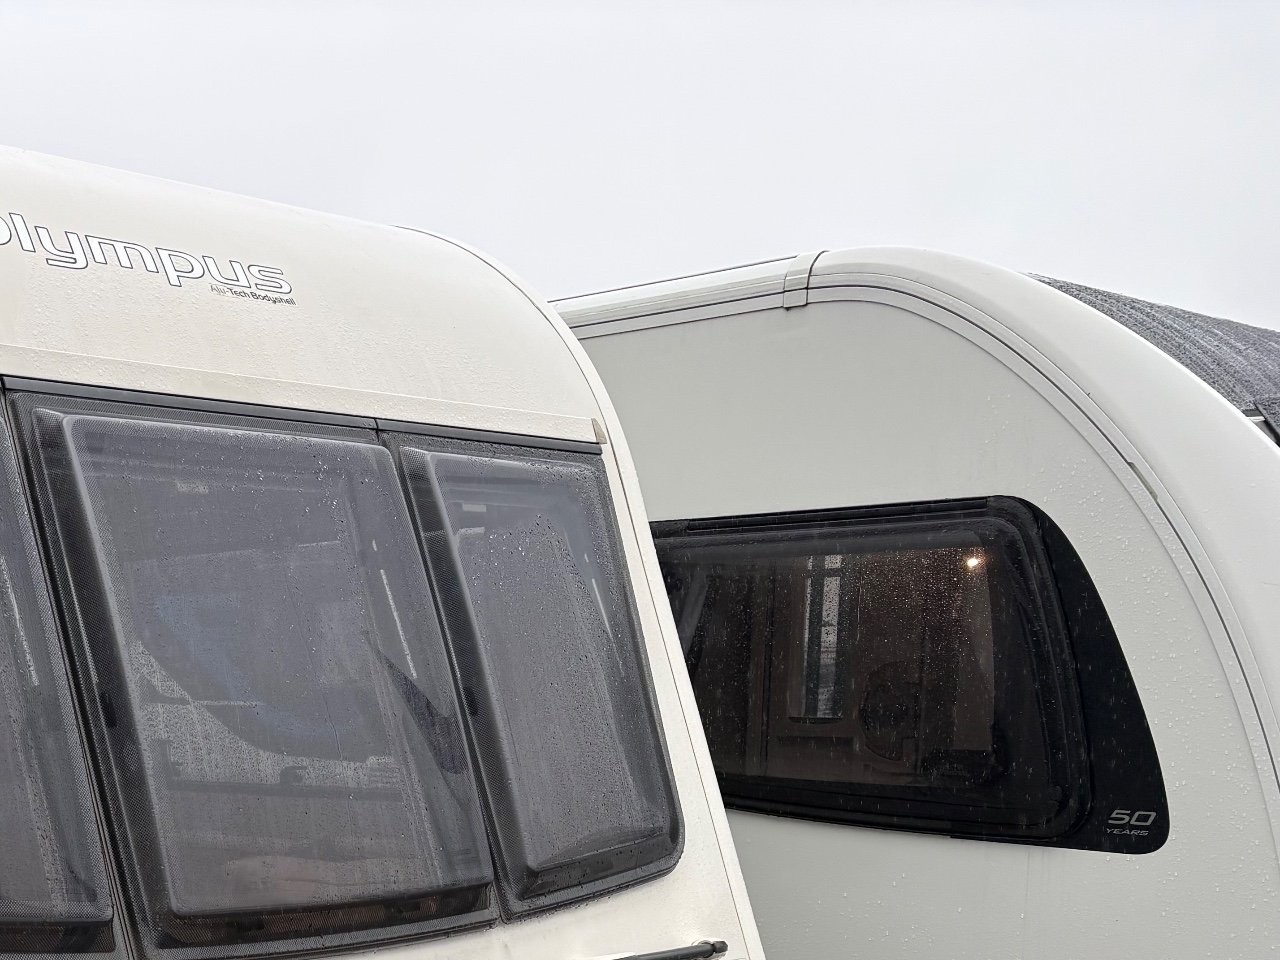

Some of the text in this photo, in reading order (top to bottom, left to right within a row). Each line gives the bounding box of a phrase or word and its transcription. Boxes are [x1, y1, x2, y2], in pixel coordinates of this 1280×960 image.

[210, 284, 297, 306] Alu-Tech Bodyshell
[1108, 809, 1157, 826] 50
[1106, 828, 1149, 836] YEARS
